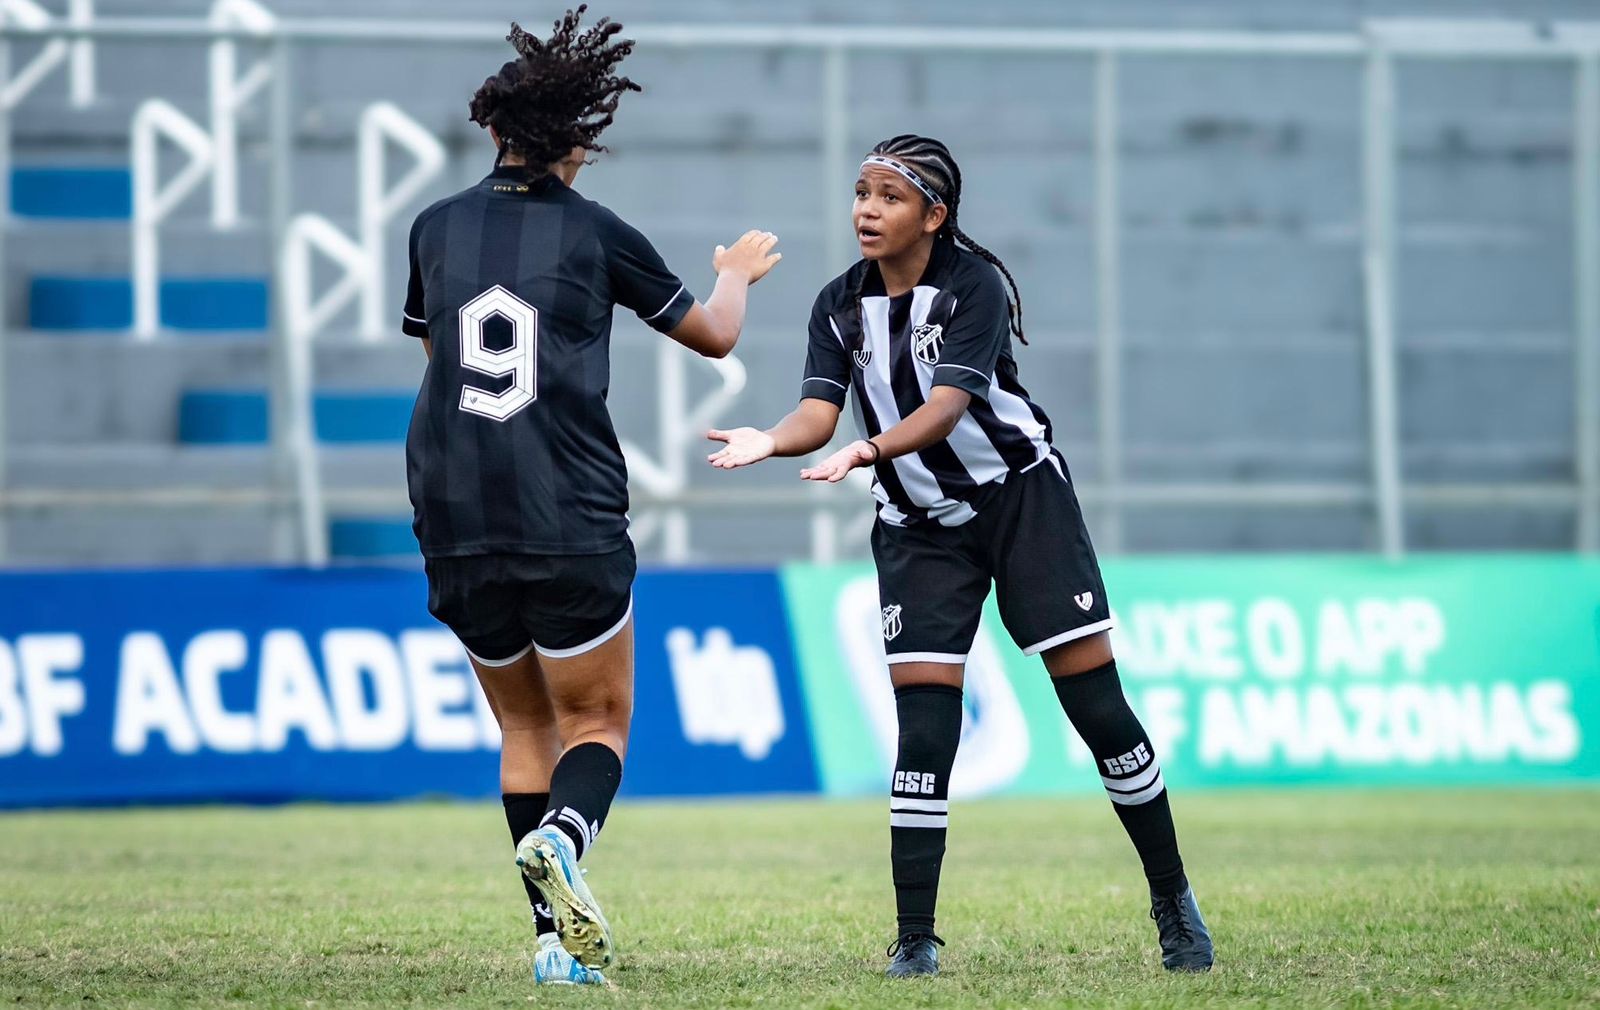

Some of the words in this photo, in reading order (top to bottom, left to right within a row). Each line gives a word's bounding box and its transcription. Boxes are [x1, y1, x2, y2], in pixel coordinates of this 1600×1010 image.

[459, 284, 538, 422] 9
[1248, 598, 1304, 680] O
[1316, 598, 1445, 677] APP
[1103, 741, 1151, 775] CSC
[1200, 681, 1576, 763] AMAZONAS
[894, 771, 936, 794] CSC
